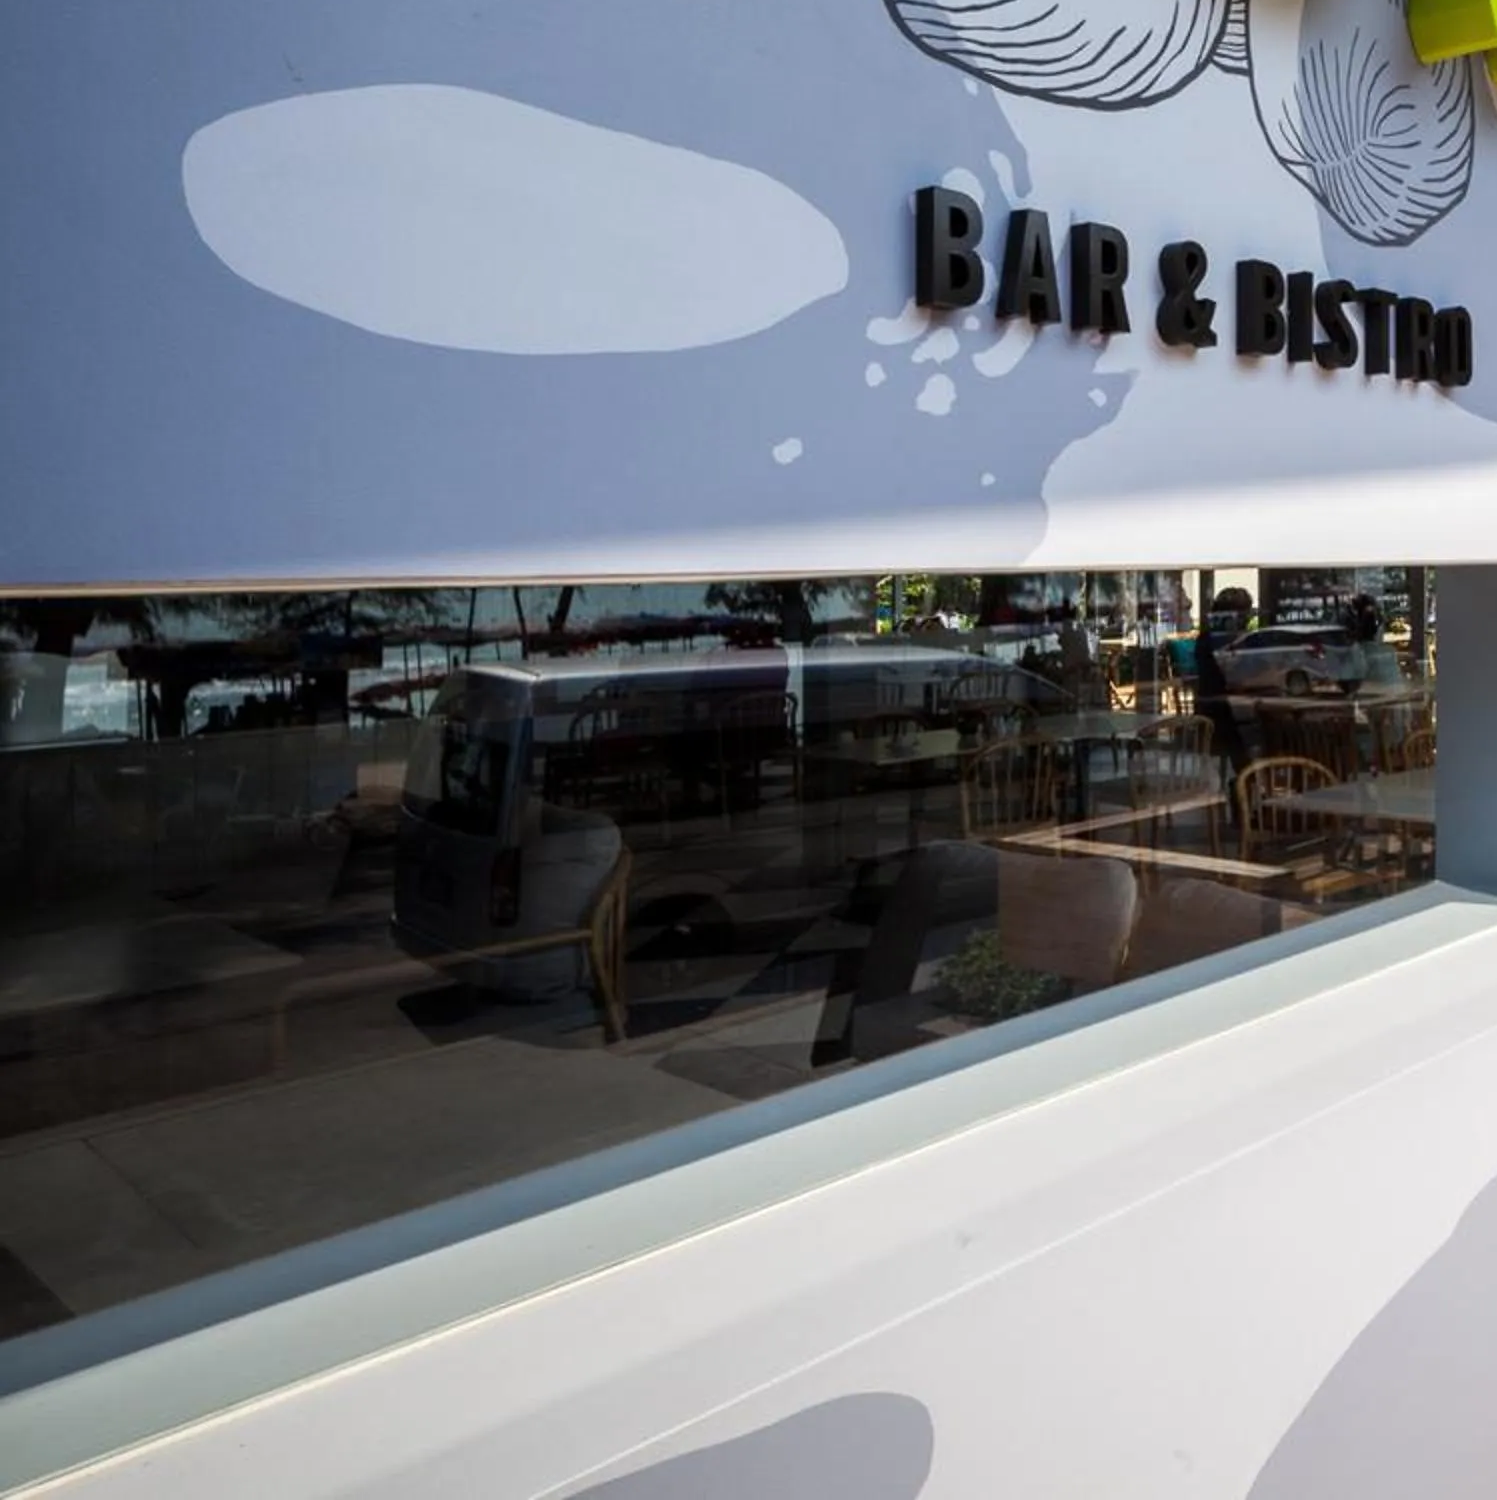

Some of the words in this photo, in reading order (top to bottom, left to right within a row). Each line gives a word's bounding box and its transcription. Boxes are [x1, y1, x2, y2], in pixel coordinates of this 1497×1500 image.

[914, 184, 1132, 333] BAR
[1156, 240, 1217, 348] &
[1235, 258, 1474, 388] BISTRO
